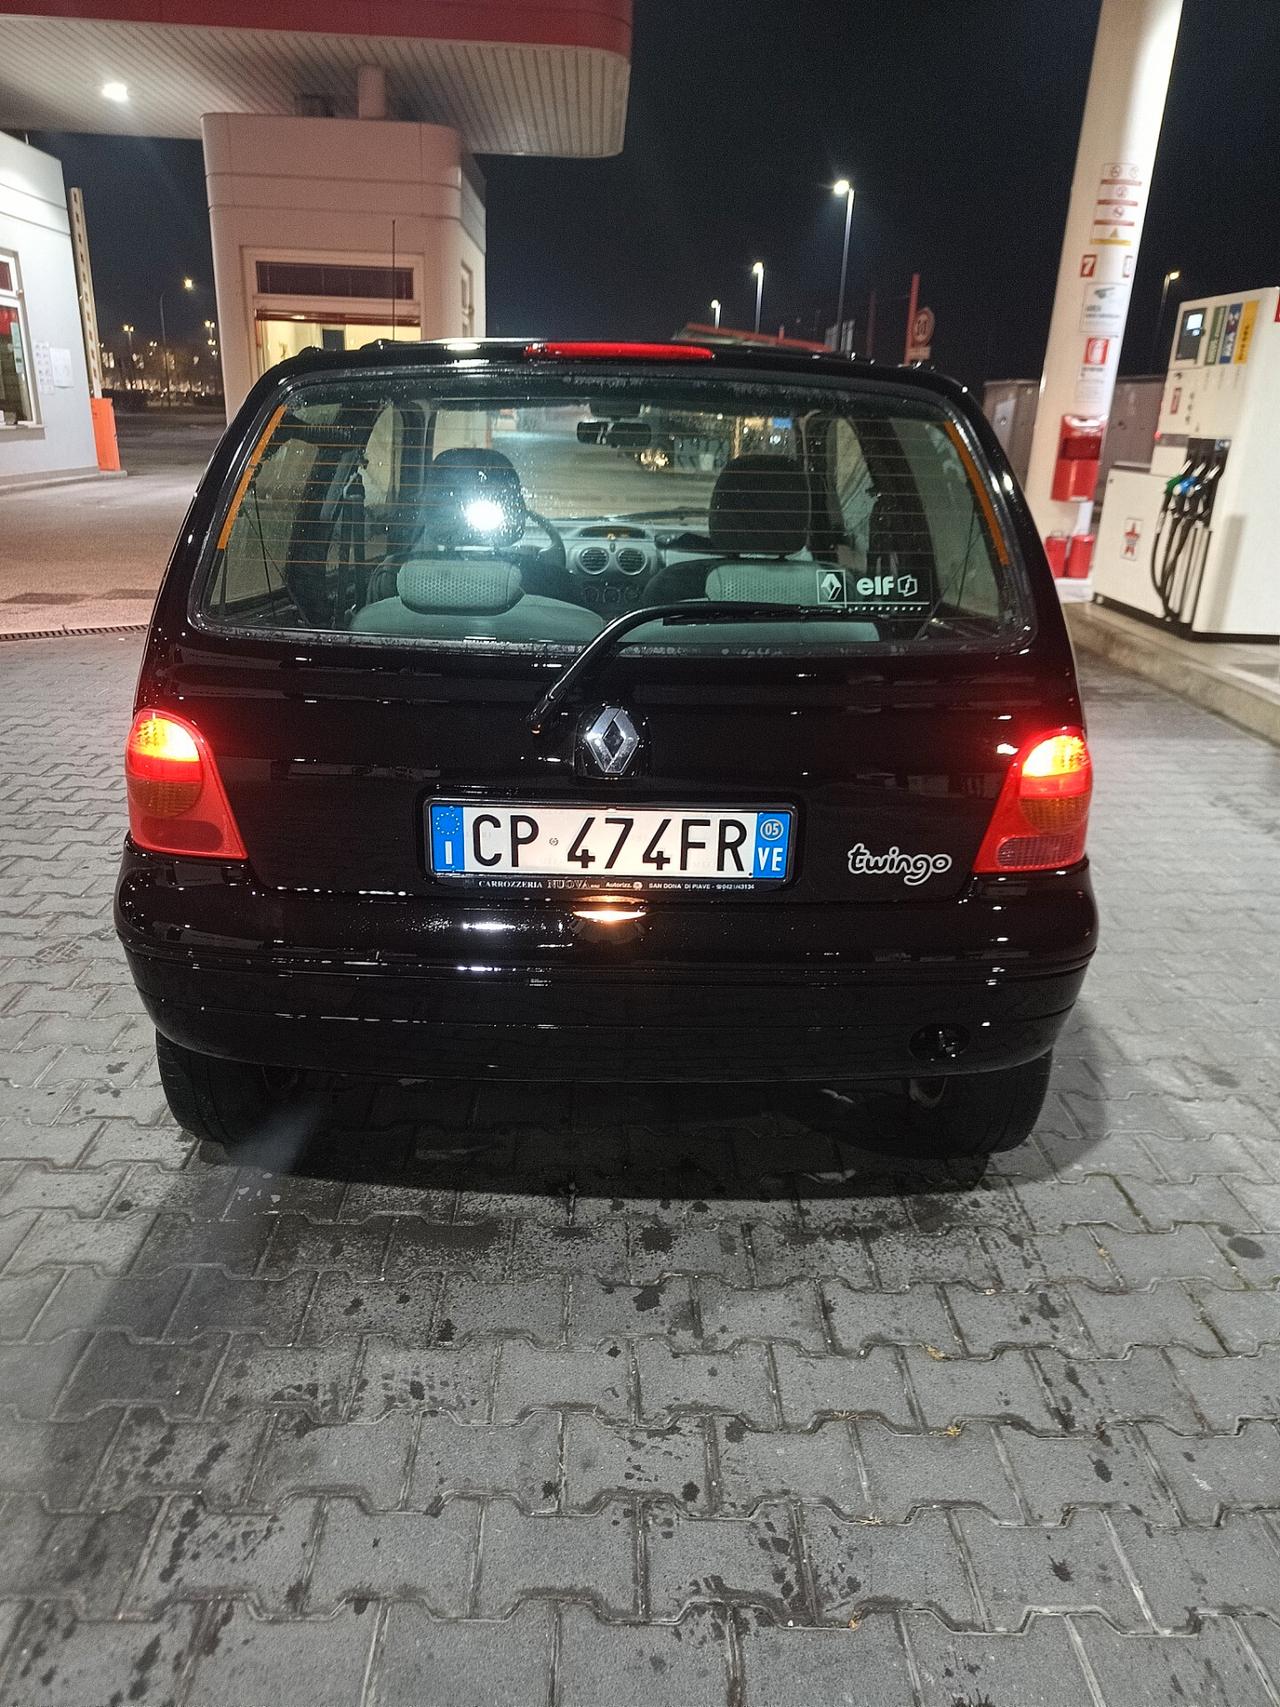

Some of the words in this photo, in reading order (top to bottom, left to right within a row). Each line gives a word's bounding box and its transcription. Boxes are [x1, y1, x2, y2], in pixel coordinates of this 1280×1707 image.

[856, 576, 894, 595] elf
[764, 822, 780, 836] 05
[472, 813, 540, 868] CP
[566, 816, 748, 871] 474FR
[757, 847, 784, 872] VE
[847, 842, 953, 886] twingo
[478, 880, 543, 889] CARROZZERIA
[546, 879, 590, 889] NUOVA
